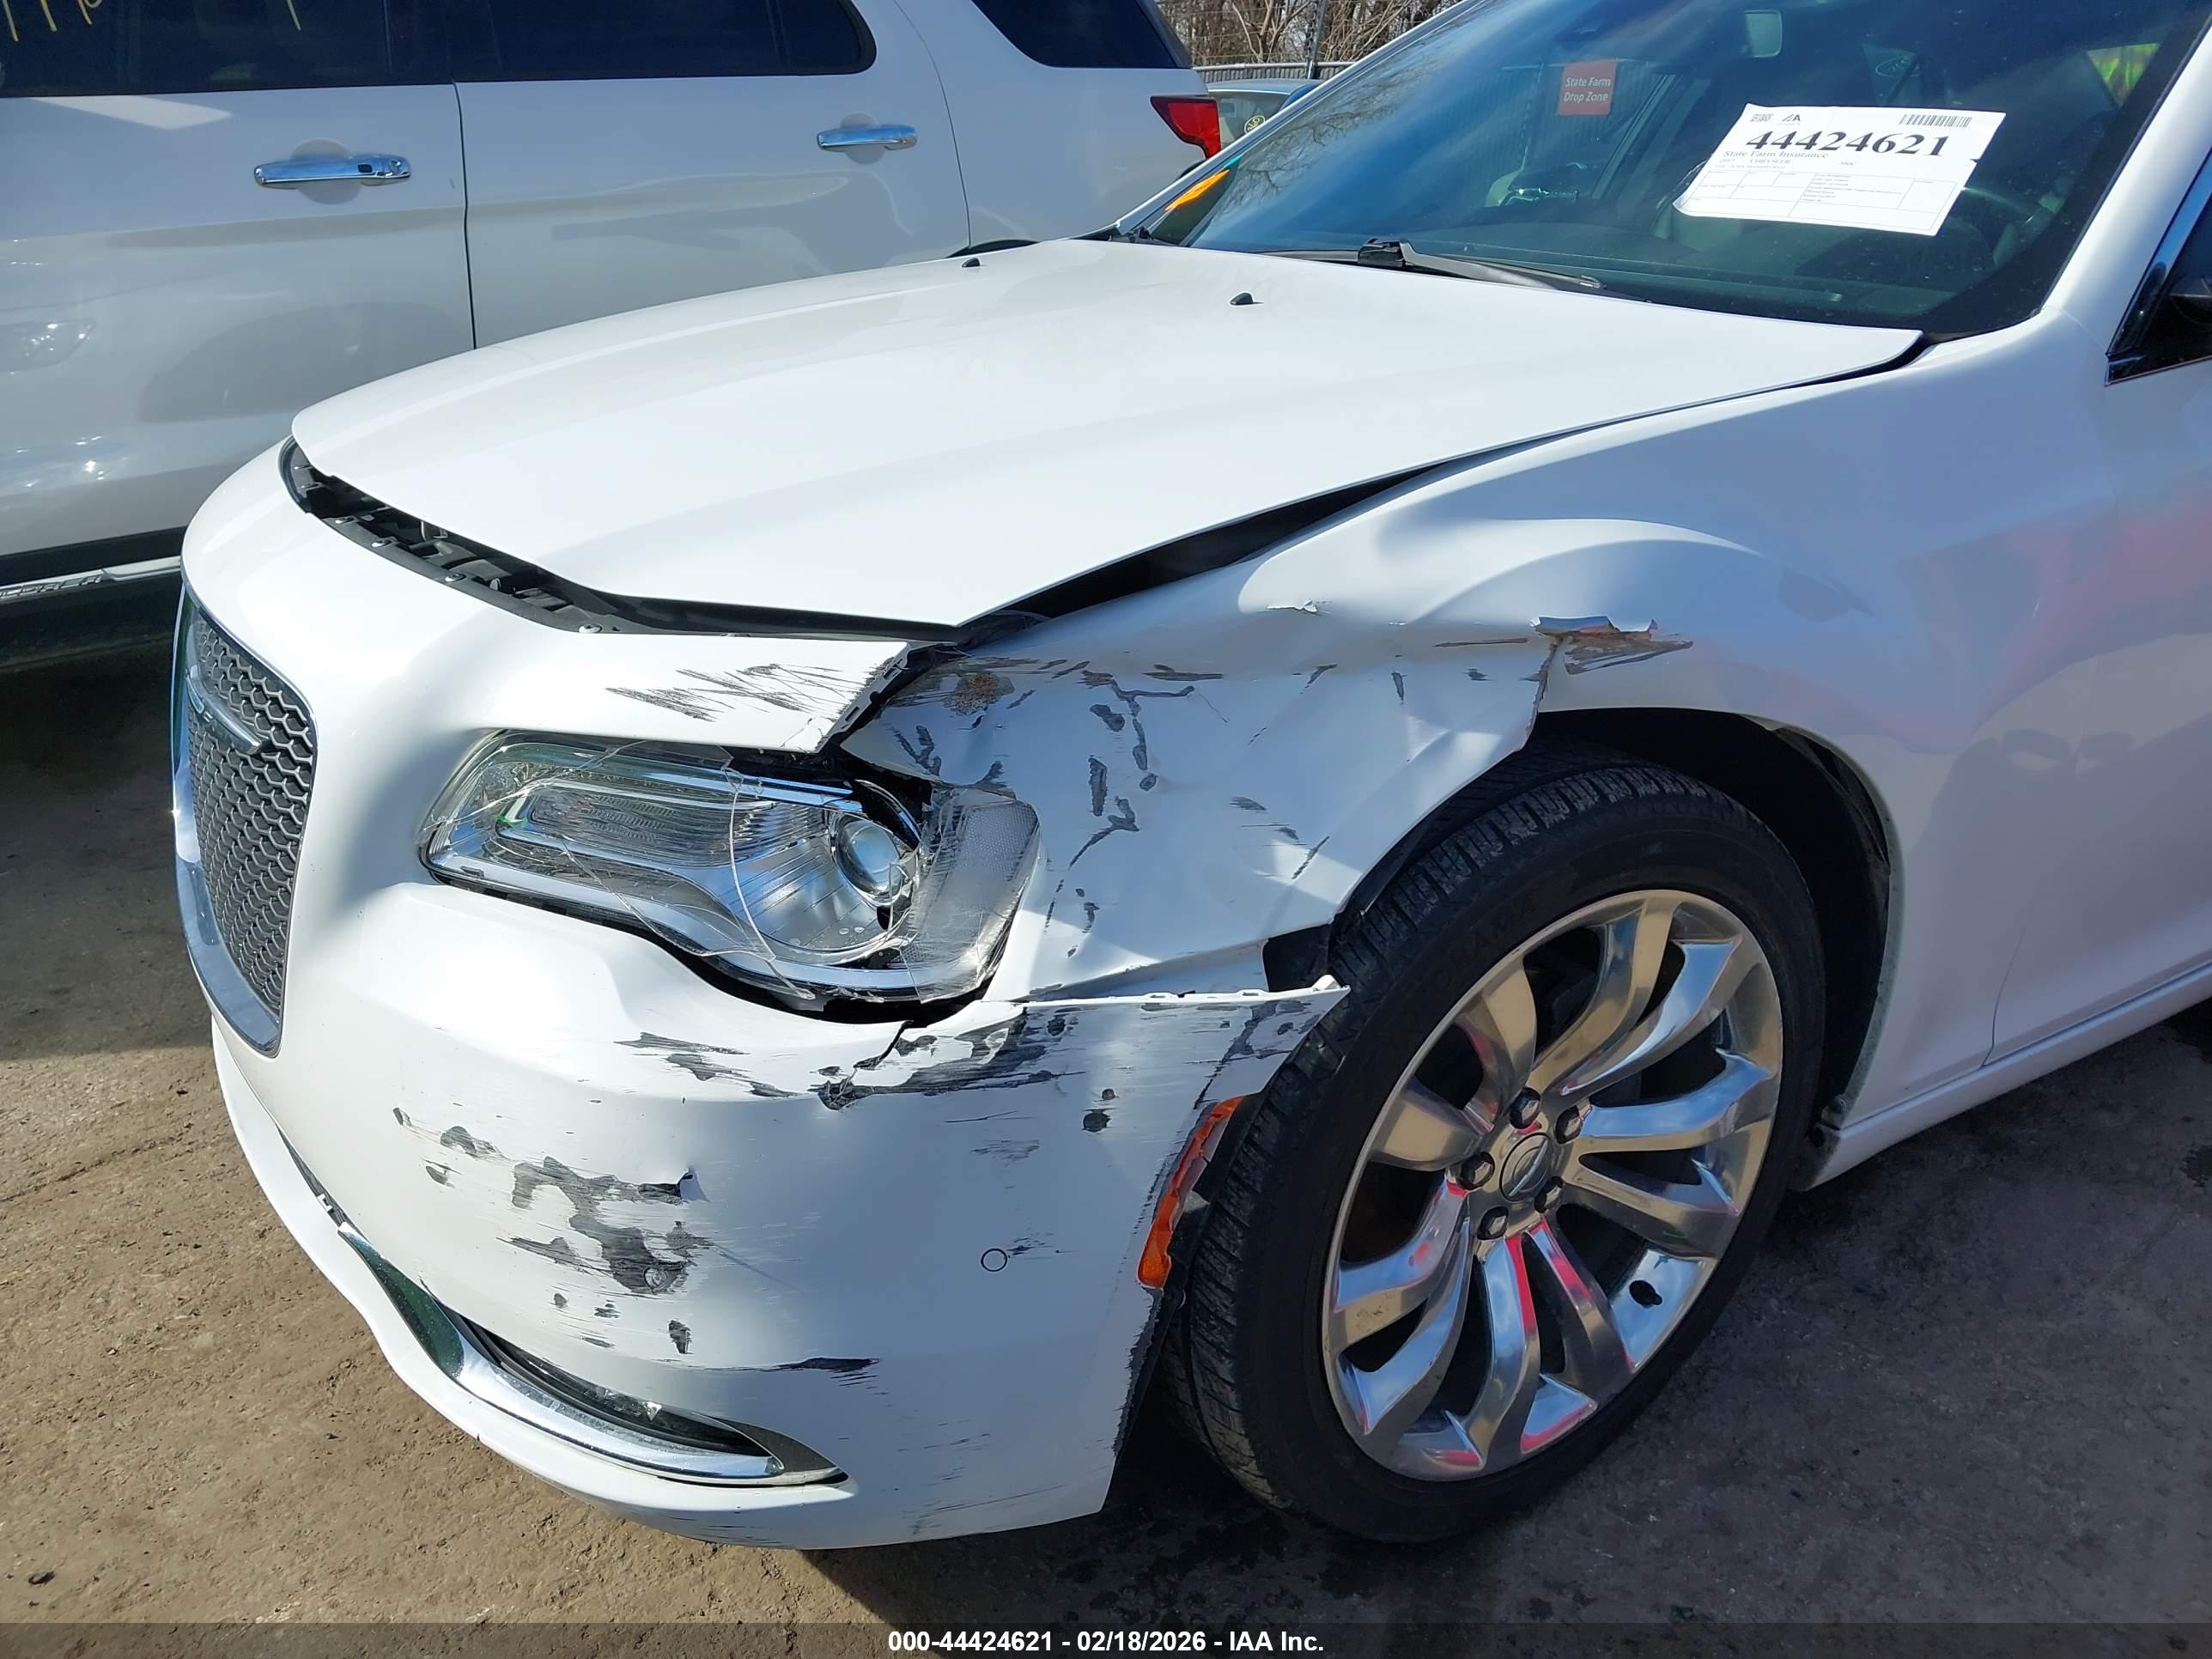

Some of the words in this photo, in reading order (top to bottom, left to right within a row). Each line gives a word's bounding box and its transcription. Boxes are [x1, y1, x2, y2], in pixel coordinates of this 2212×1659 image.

[1565, 77, 1588, 88] State
[1589, 76, 1612, 87] Farm
[1563, 92, 1584, 103] Drop
[1585, 91, 1608, 102] Zone
[1746, 130, 1949, 157] 44424621
[1778, 150, 1830, 159] Insurance
